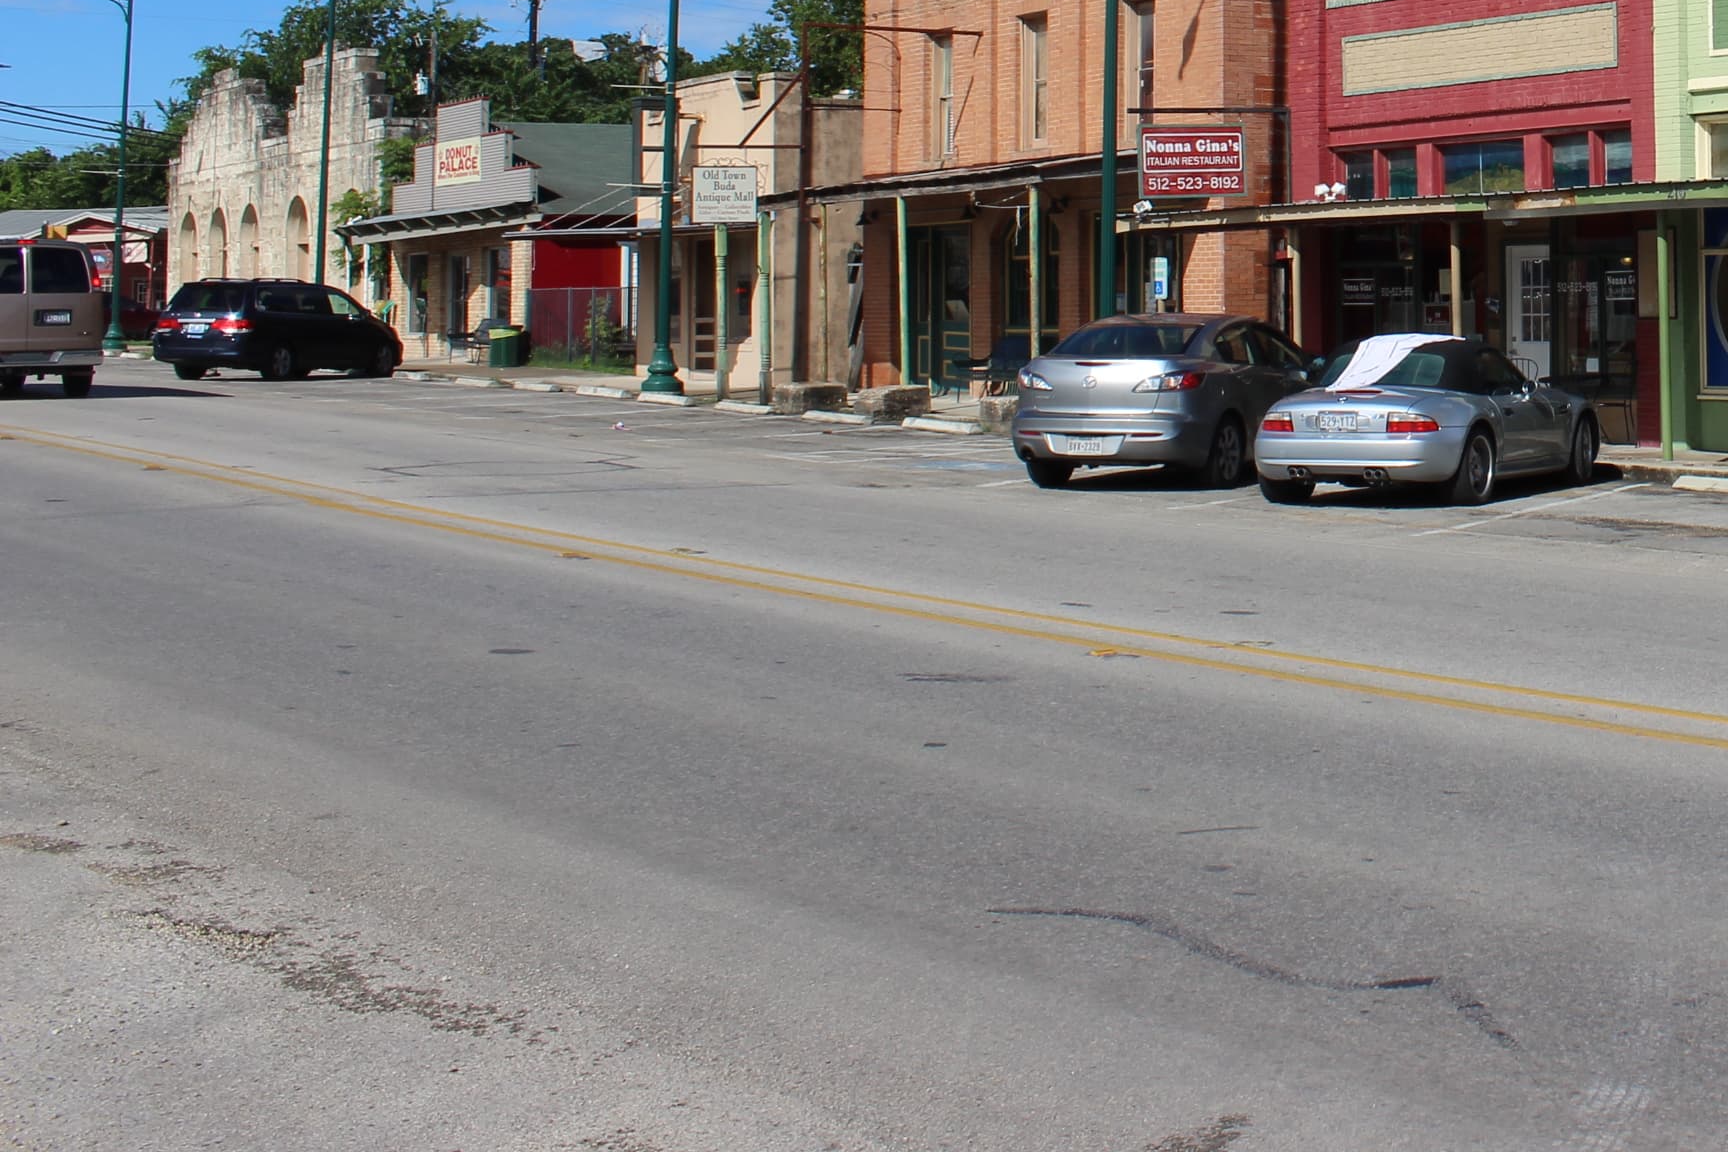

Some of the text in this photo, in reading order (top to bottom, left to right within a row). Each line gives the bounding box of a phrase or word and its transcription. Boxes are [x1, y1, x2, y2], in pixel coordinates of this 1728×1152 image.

[445, 144, 472, 160] DONUT
[1146, 139, 1239, 153] Nonna Gina's
[440, 156, 478, 173] PALACE
[1147, 155, 1238, 166] ITALIAN RESTAURANT
[703, 169, 747, 180] Old Town
[713, 180, 736, 190] Buda
[1148, 175, 1239, 190] 512-523-8192
[696, 192, 754, 204] Antique Mall
